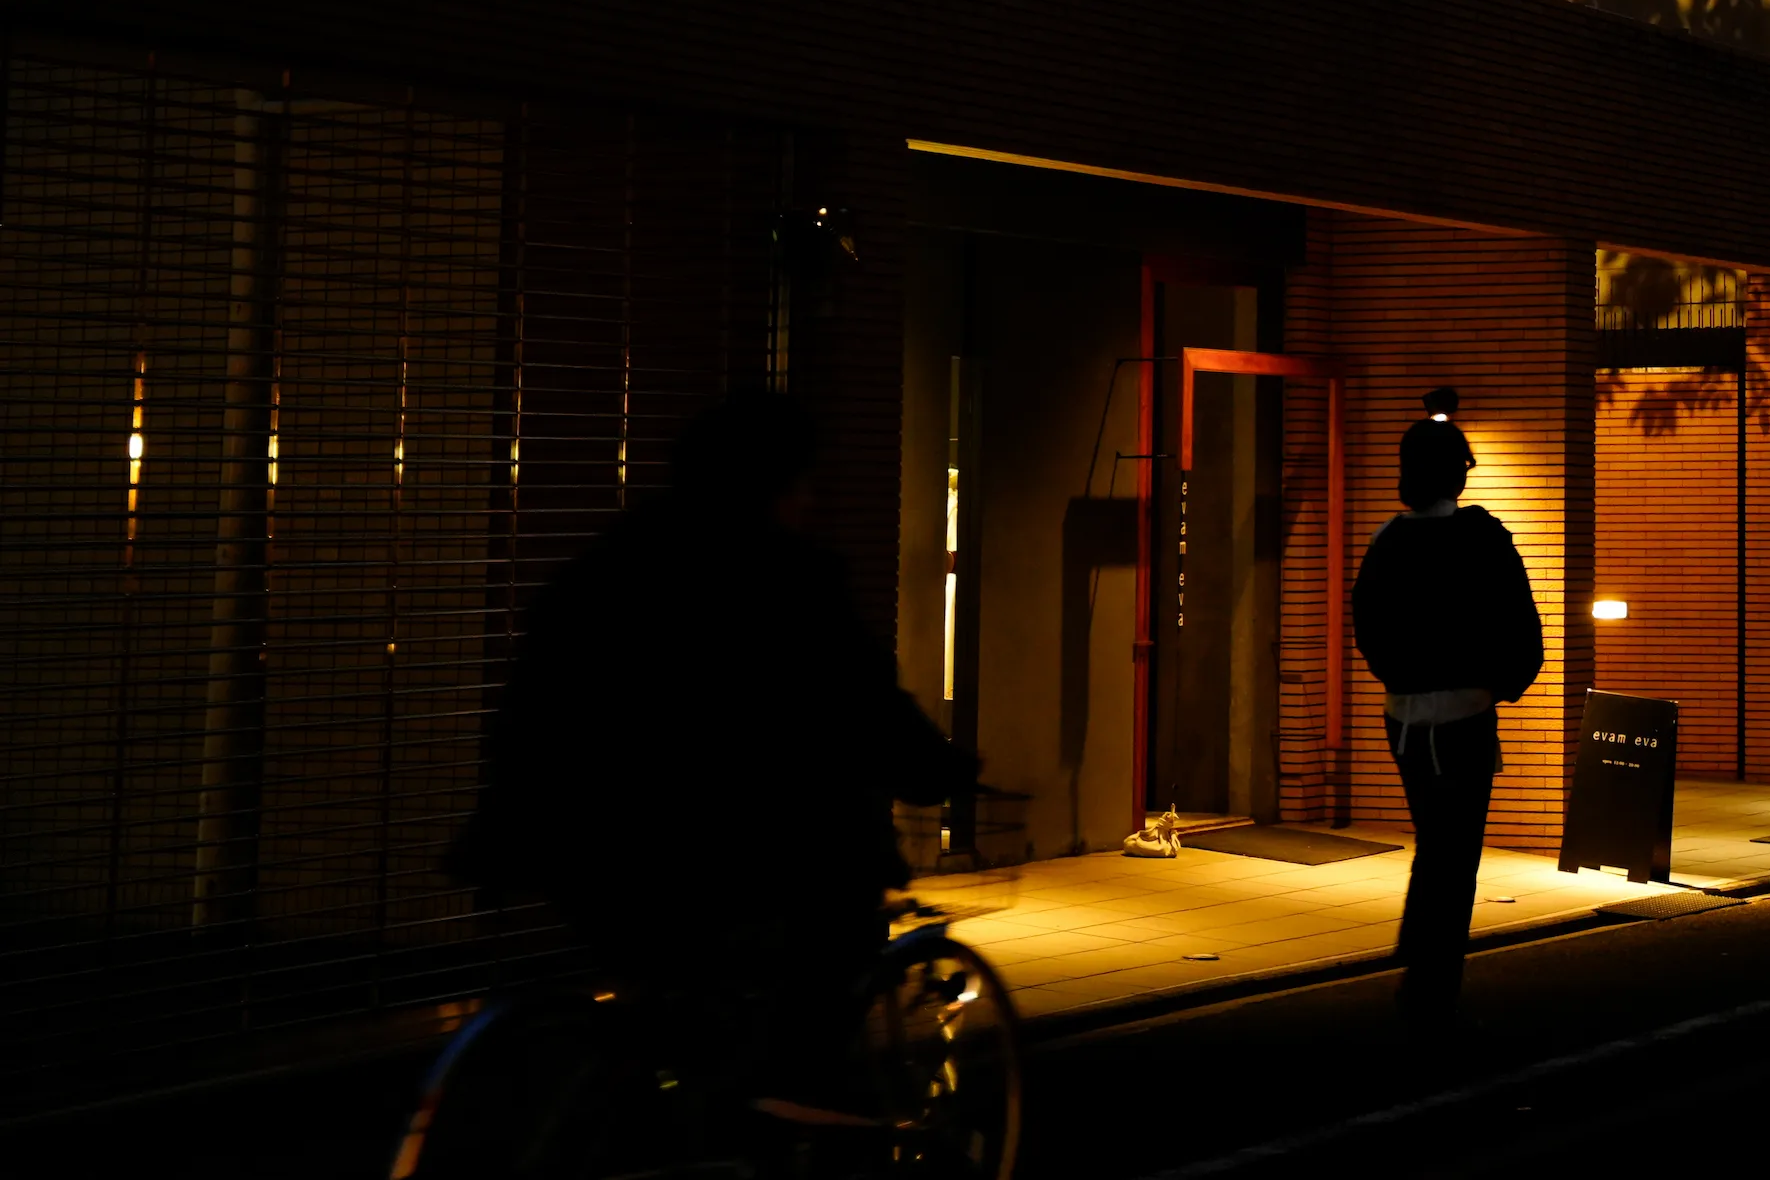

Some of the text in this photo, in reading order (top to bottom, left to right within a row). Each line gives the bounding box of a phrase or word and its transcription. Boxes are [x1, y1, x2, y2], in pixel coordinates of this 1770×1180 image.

[1177, 481, 1188, 627] evam eva
[1592, 730, 1658, 748] evam eva
